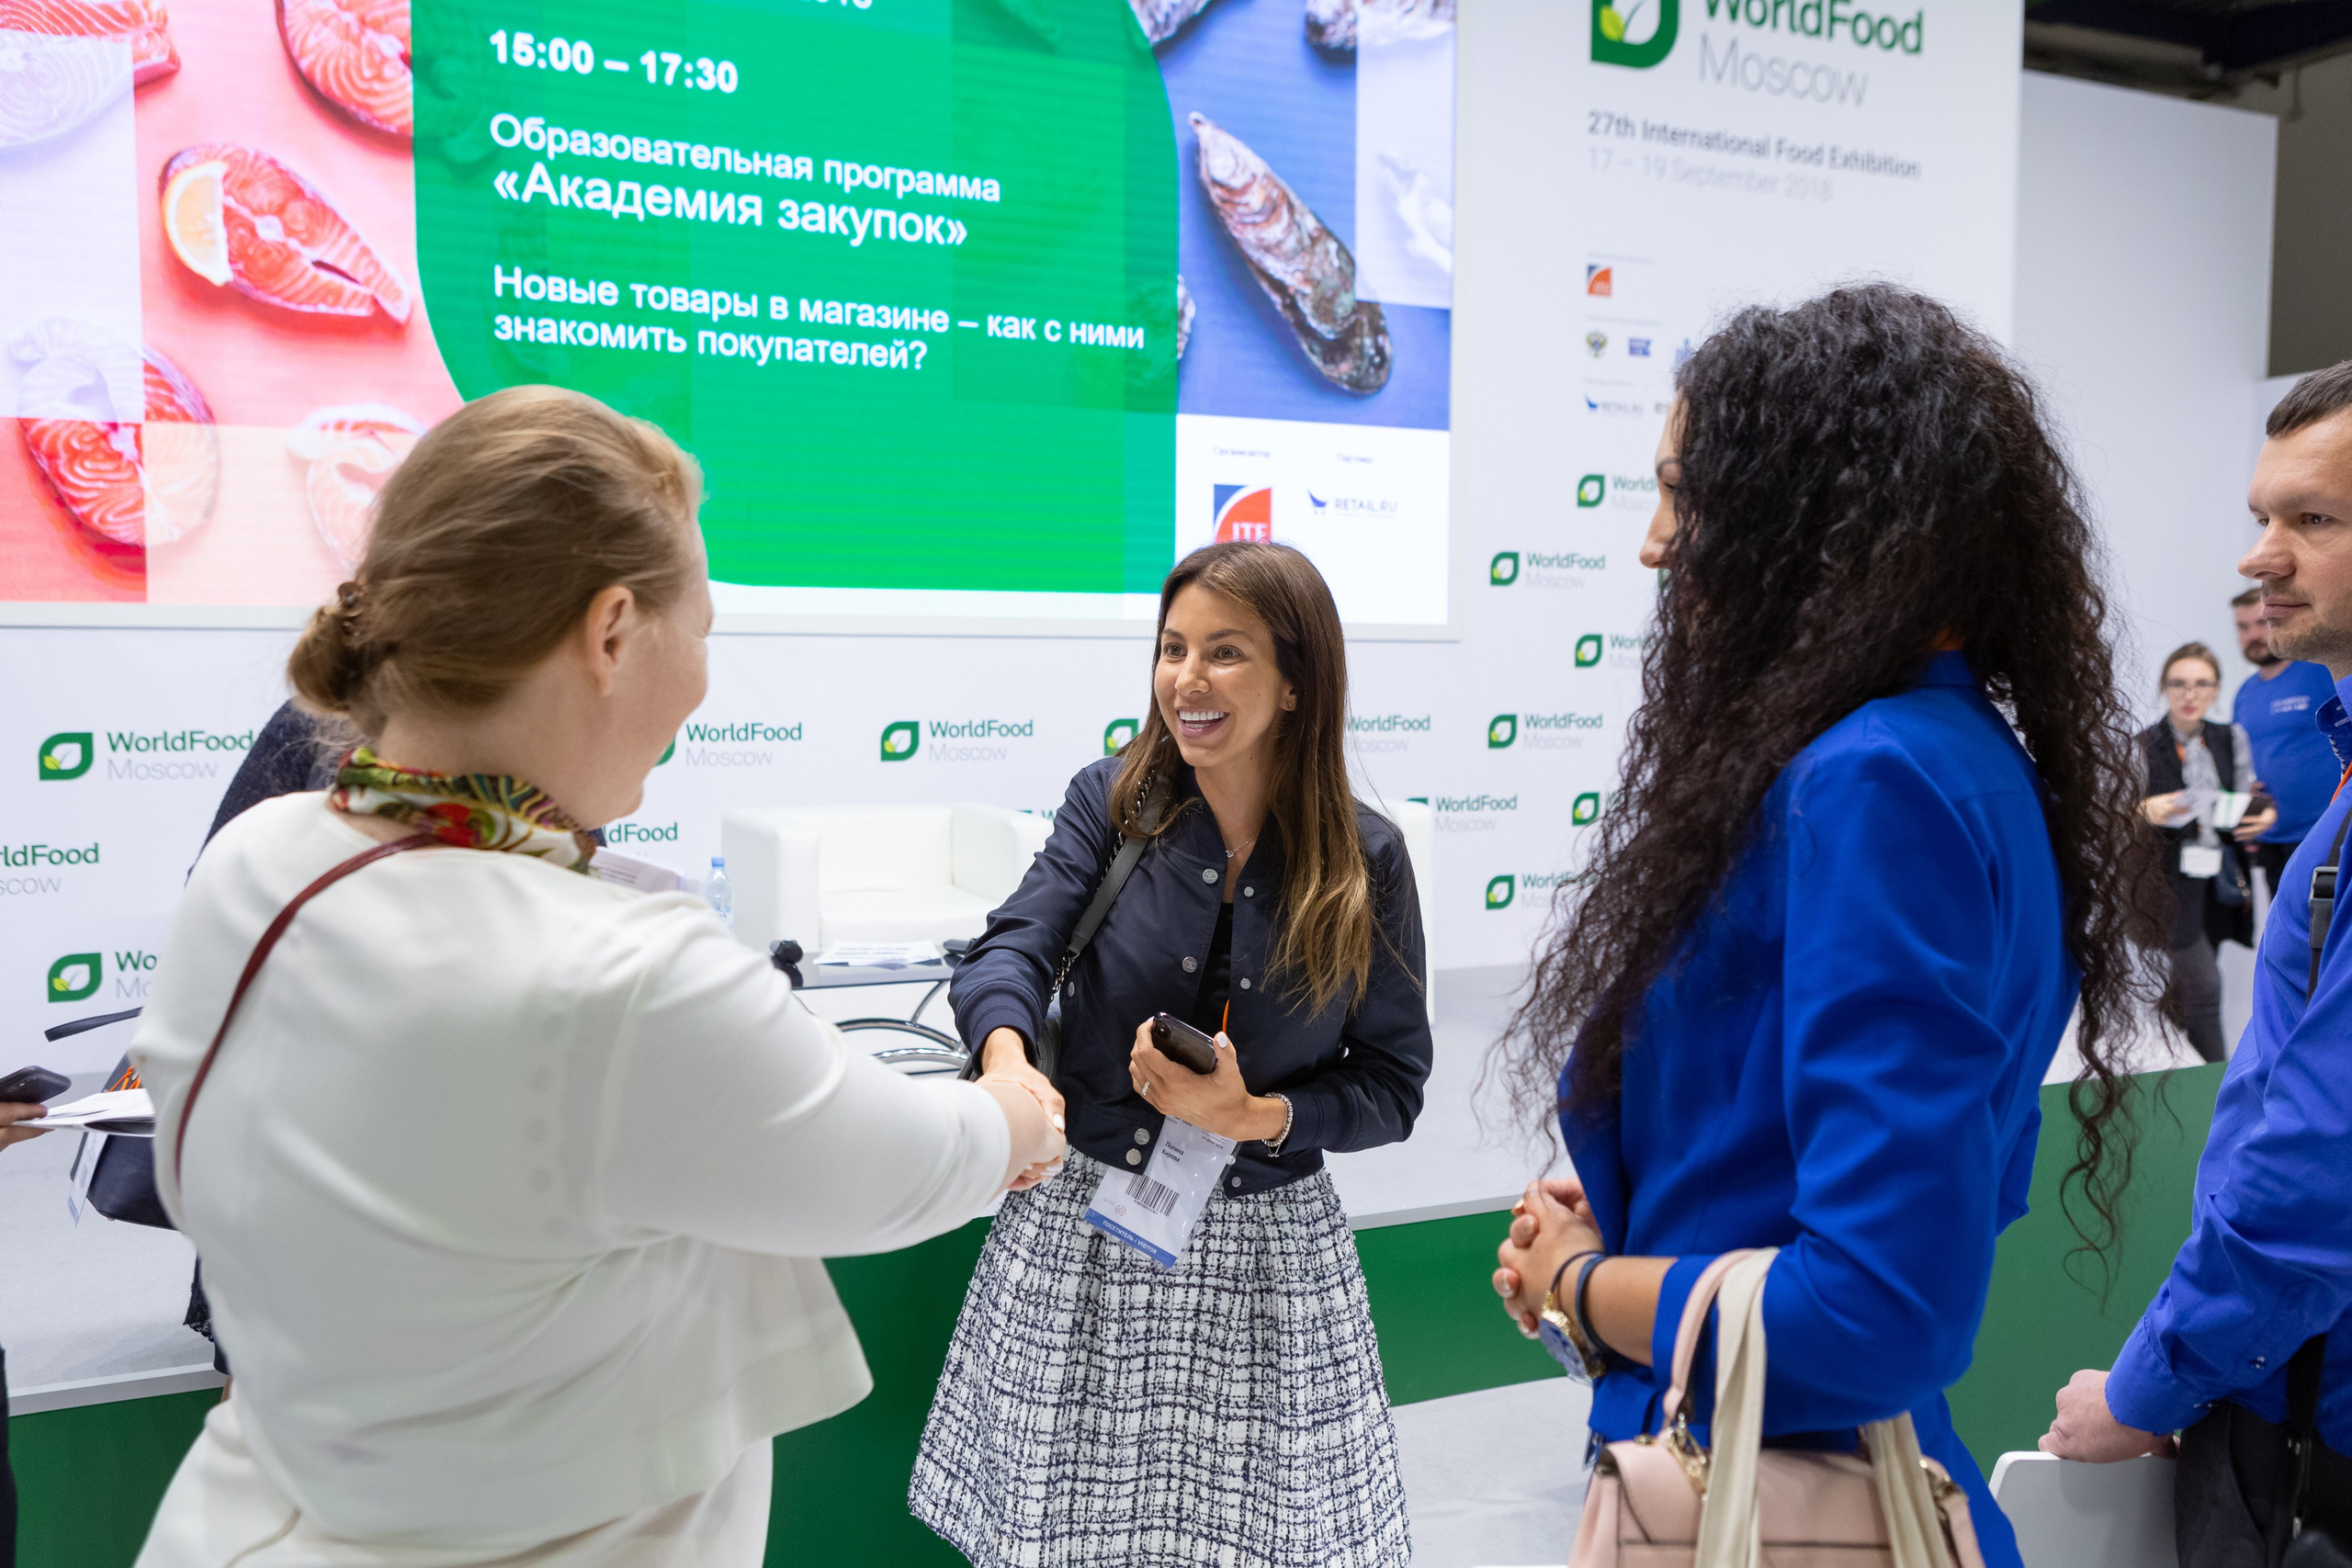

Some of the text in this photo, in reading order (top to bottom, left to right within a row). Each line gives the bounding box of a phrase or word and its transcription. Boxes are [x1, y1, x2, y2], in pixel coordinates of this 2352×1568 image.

[491, 30, 594, 73] 15:00
[640, 51, 738, 93] 17:30
[1700, 34, 1868, 106] Moscow
[1587, 111, 1922, 180] 27th International Food Exhibition
[491, 114, 1000, 201] Образовательная программа
[1588, 146, 1613, 171] 17
[1643, 154, 1666, 181] 19
[1670, 158, 1779, 195] September
[494, 163, 967, 245] «Академия закупок»
[495, 265, 618, 306] Новые
[630, 284, 757, 321] товары
[771, 297, 788, 320] в
[800, 299, 949, 332] магазине
[988, 315, 1035, 339] как
[1045, 321, 1061, 342] с
[1070, 322, 1143, 348] ними
[495, 315, 927, 369] знакомить покупателей?
[1527, 553, 1606, 570] WorldFood
[686, 722, 802, 741] WorldFood
[929, 719, 1034, 738] WorldFood
[1346, 716, 1430, 732] WorldFood
[1524, 714, 1602, 729] WorldFood
[107, 730, 254, 752] WorldFood
[1523, 733, 1583, 750] Moscow
[685, 747, 773, 767] Moscow
[929, 743, 1007, 761] Moscow
[107, 758, 219, 780] Moscow
[1436, 794, 1518, 812] WorldFood
[603, 822, 678, 843] ldFood
[1434, 816, 1497, 833] Moscow
[1161, 1148, 1181, 1163] Кирова
[1165, 1141, 1184, 1156] Полина
[1102, 1220, 1134, 1242] ПОСЕТИТЕЛЬ
[1137, 1239, 1158, 1255] VISITOR
